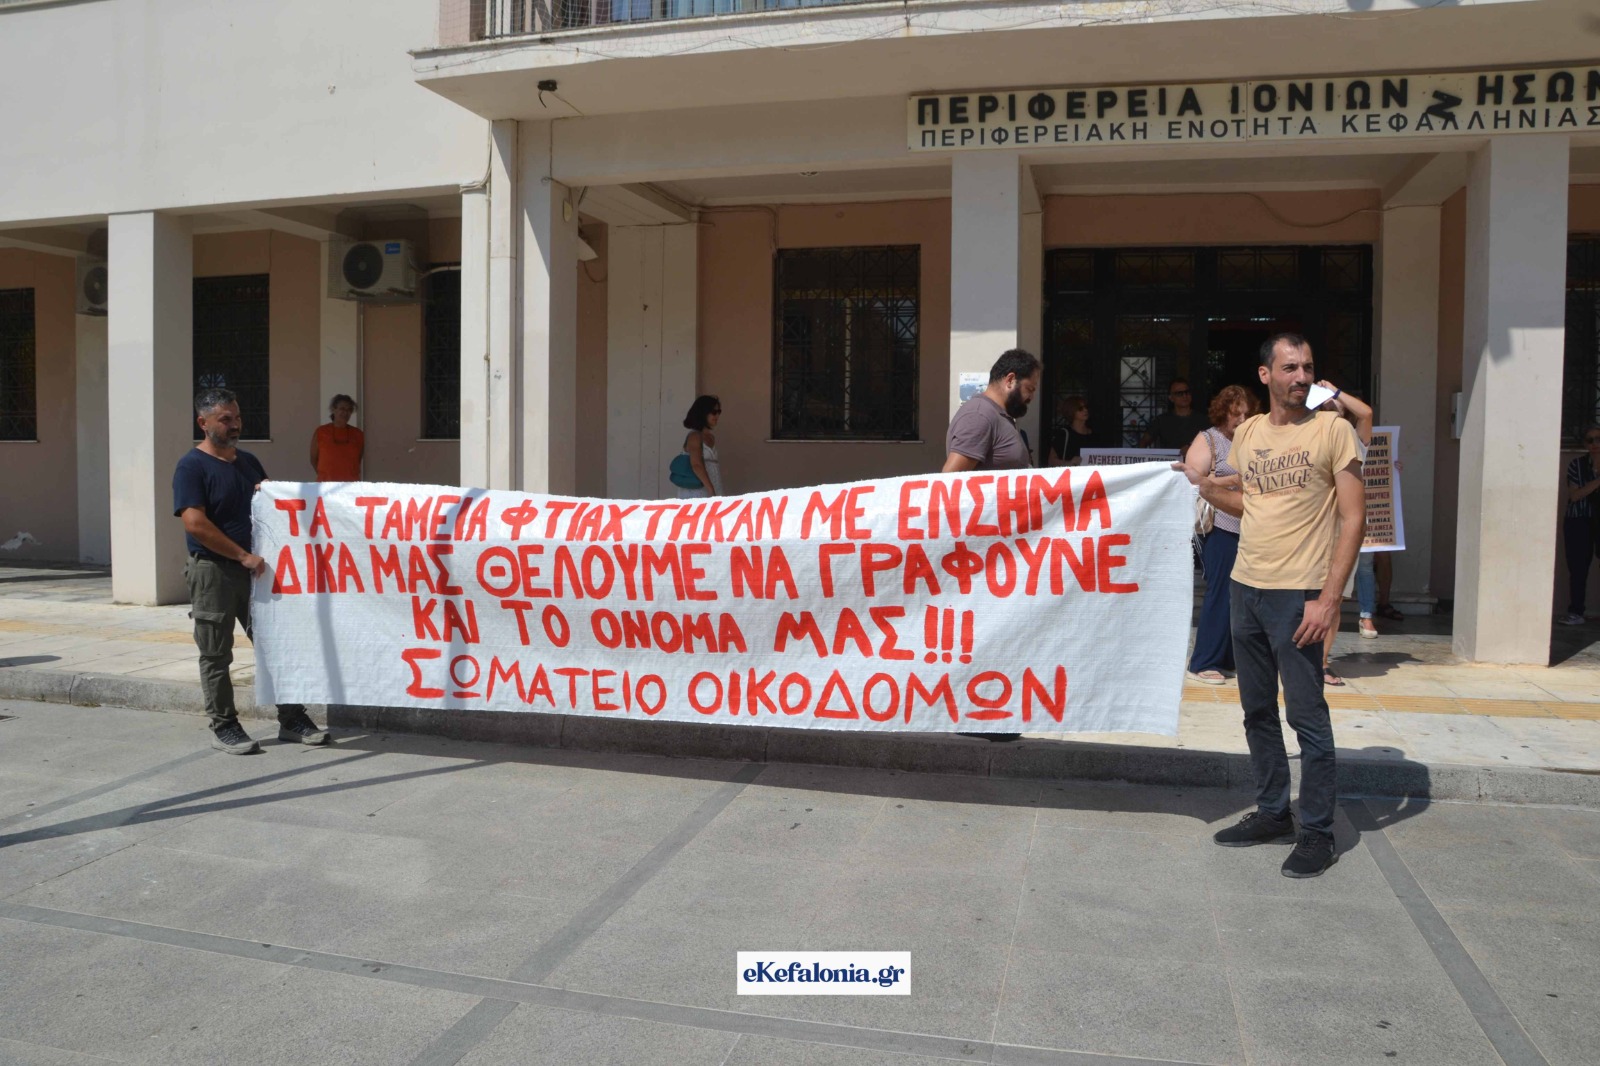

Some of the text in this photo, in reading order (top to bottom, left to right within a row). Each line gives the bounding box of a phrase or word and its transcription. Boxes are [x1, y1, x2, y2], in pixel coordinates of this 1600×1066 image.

[918, 87, 1202, 125] ΠΕΡΙΦΕΡΕΙΑ
[1230, 79, 1408, 114] ΙΟΝΙΩΝ
[921, 106, 1600, 147] ΠΕΡΙΦΕΡΕΙΑΚΗ ΕΝΟΤΗΤΑ ΚΕΦΑΛΛΗΝΙΑΣ
[1088, 454, 1122, 465] ΑΥΞΗΣΕΙΣ
[1244, 451, 1314, 481] SUPERIOR
[1256, 468, 1313, 496] VINTAGE
[274, 468, 1112, 543] ΤΑ ΤΑΜΕΙΑ ΦΤΙΑΧΤΗΚΑΝ ΜΕ ΕΝΣΗΜΑ
[369, 543, 465, 596] ΜΑΣ
[476, 543, 717, 601] ΘΕΛΟΥΜΕ
[730, 545, 800, 600] ΝΑ
[818, 533, 1140, 599] ΓΡΑΦΟΥΝΕ
[411, 596, 481, 645] ΚΑΙ
[501, 600, 571, 649] ΤΟ
[591, 608, 748, 654] ΟΝΟΜΑ
[401, 648, 1068, 724] ΣΩΜΑΤΕΙΟ ΟΙΚΟΔΟΜΩΝ
